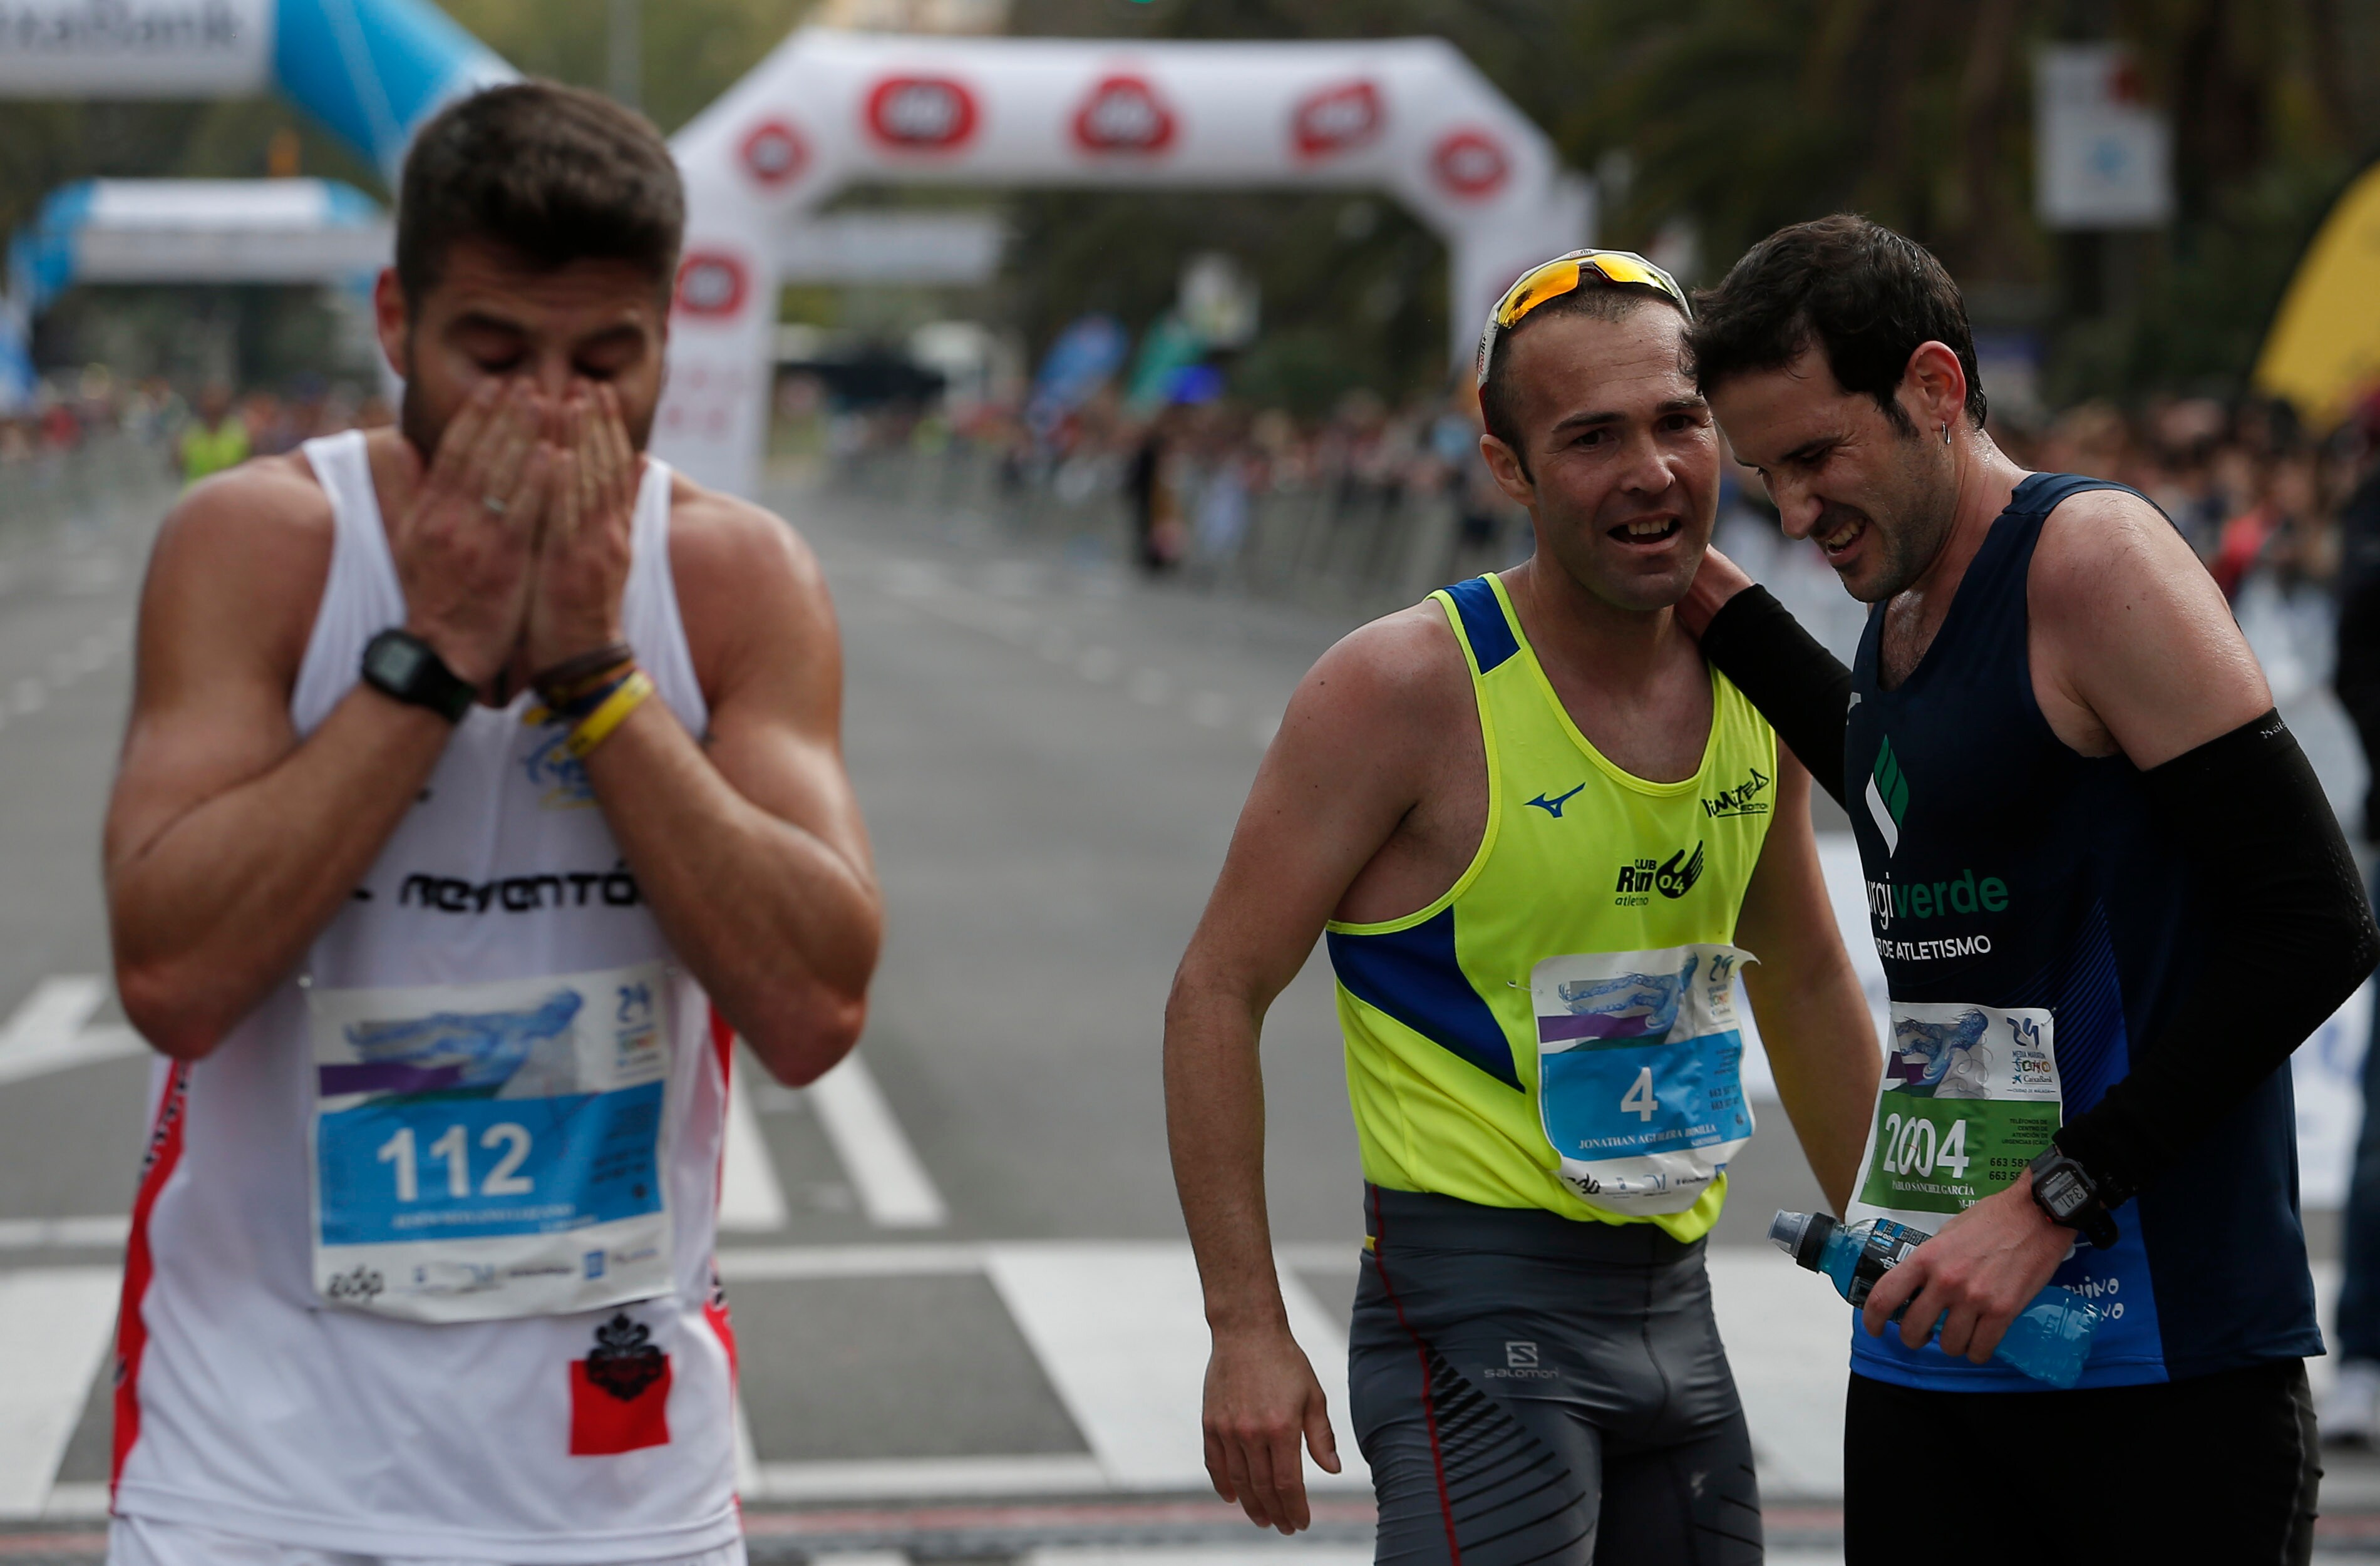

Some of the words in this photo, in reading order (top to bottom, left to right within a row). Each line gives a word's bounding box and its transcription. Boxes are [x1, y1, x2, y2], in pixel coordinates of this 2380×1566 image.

[1882, 939, 1895, 959] DE
[1897, 935, 1991, 961] ATLETISMO
[2023, 1075, 2053, 1083] CaixaBank
[1620, 1066, 1659, 1122] 4
[1579, 1135, 1636, 1150] JONATHAN
[1883, 1113, 1970, 1178] 2004
[378, 1122, 534, 1202] 112
[1990, 1158, 2008, 1167] 663
[1989, 1171, 2007, 1180] 663
[1942, 1183, 1975, 1195] GARCÍA
